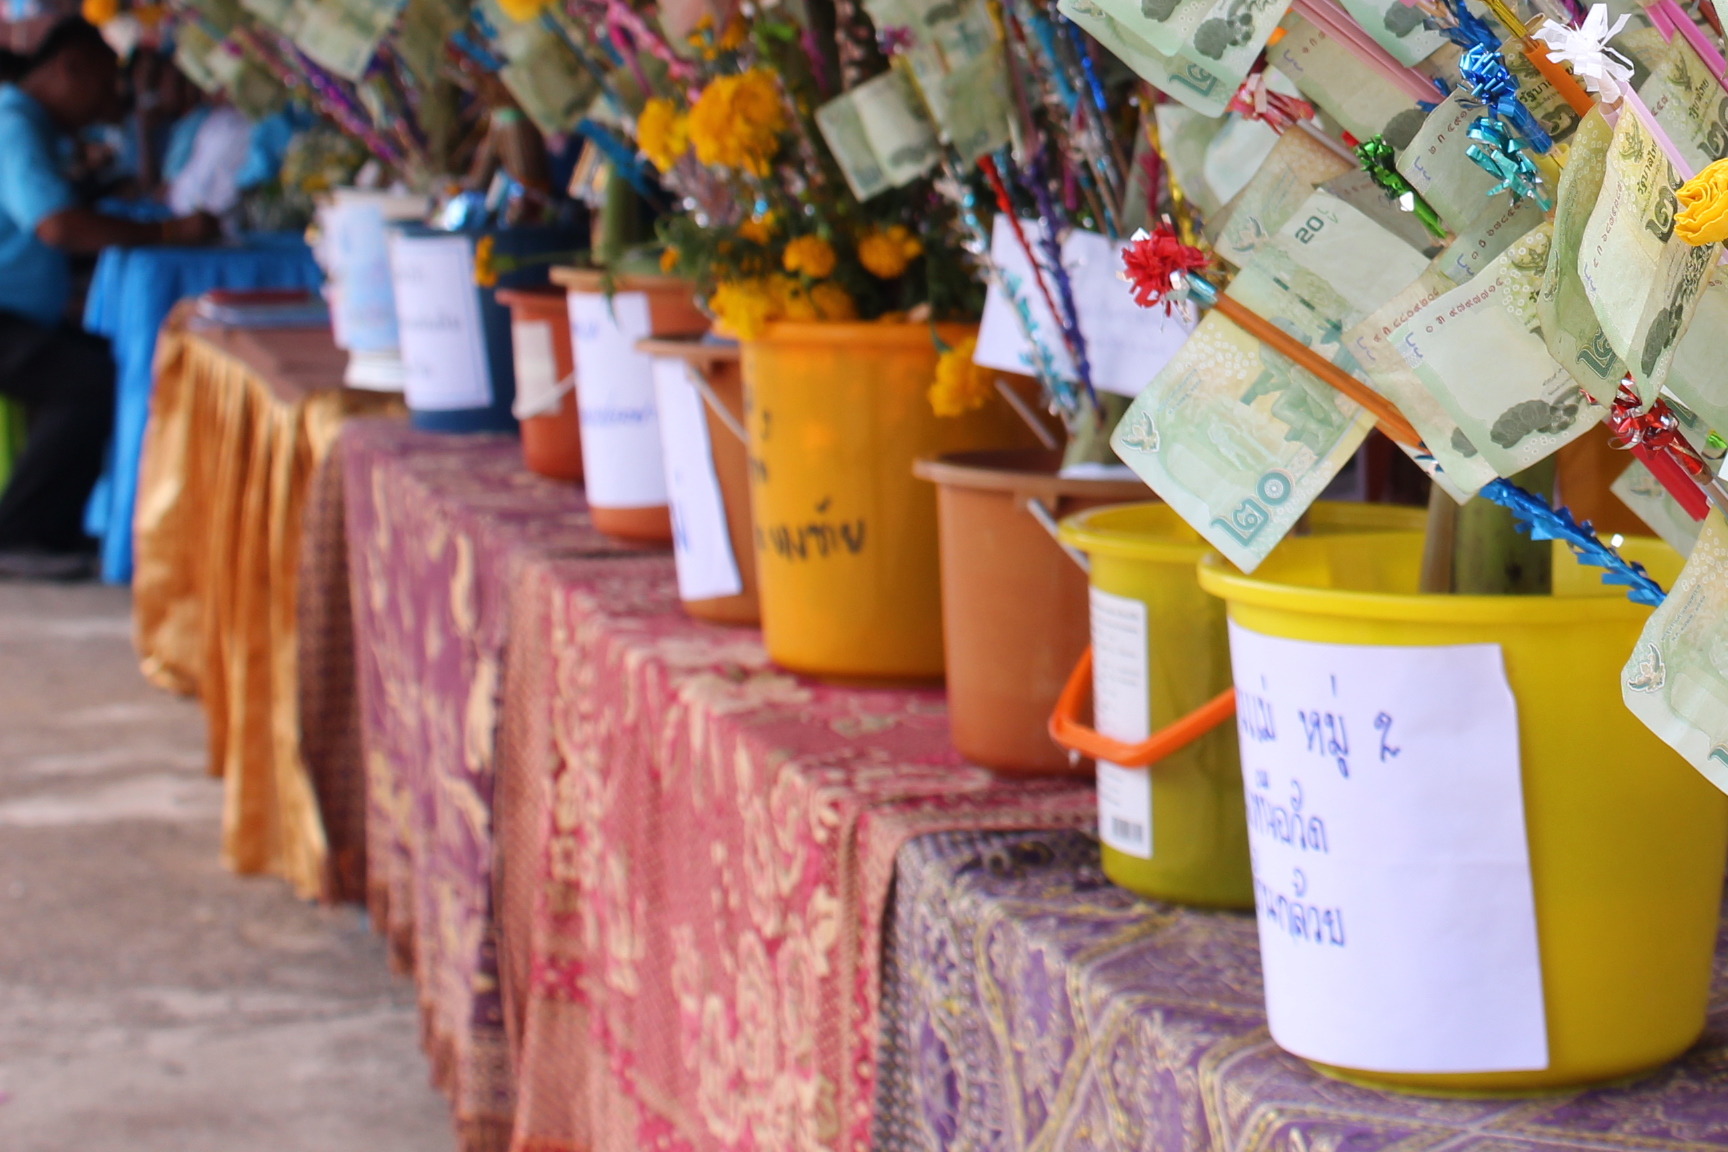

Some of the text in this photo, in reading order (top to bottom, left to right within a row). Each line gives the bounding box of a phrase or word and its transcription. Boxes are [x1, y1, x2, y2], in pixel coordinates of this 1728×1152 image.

[1295, 214, 1324, 246] 20
[1210, 467, 1295, 546] ๒๐
[1298, 674, 1349, 780] หมู่
